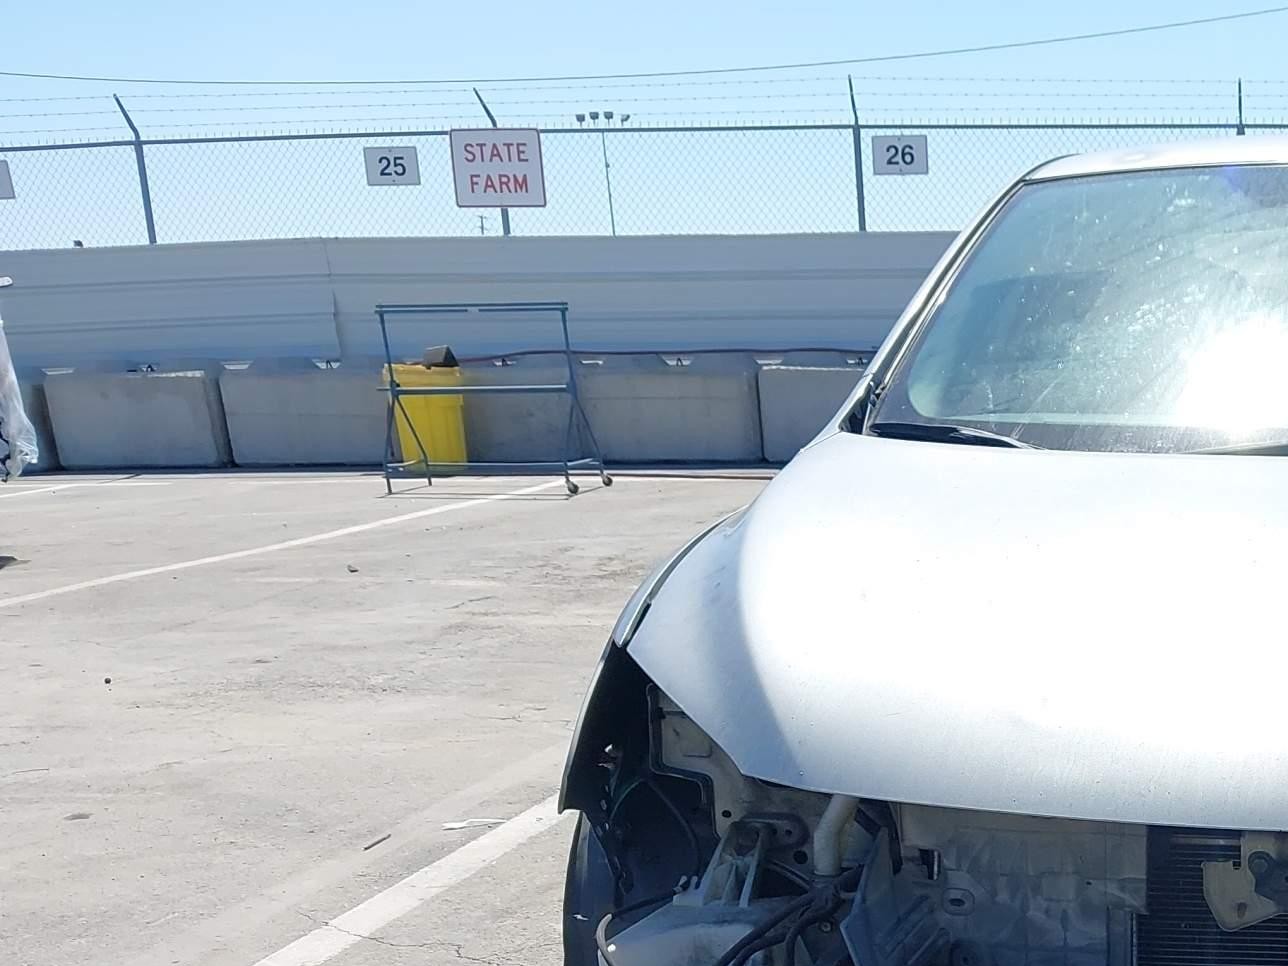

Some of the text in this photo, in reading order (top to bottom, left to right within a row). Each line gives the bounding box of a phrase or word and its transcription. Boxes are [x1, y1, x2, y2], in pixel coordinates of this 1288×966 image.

[463, 142, 529, 163] STATE
[886, 144, 915, 166] 26
[378, 156, 407, 177] 25
[469, 173, 529, 194] FARM
